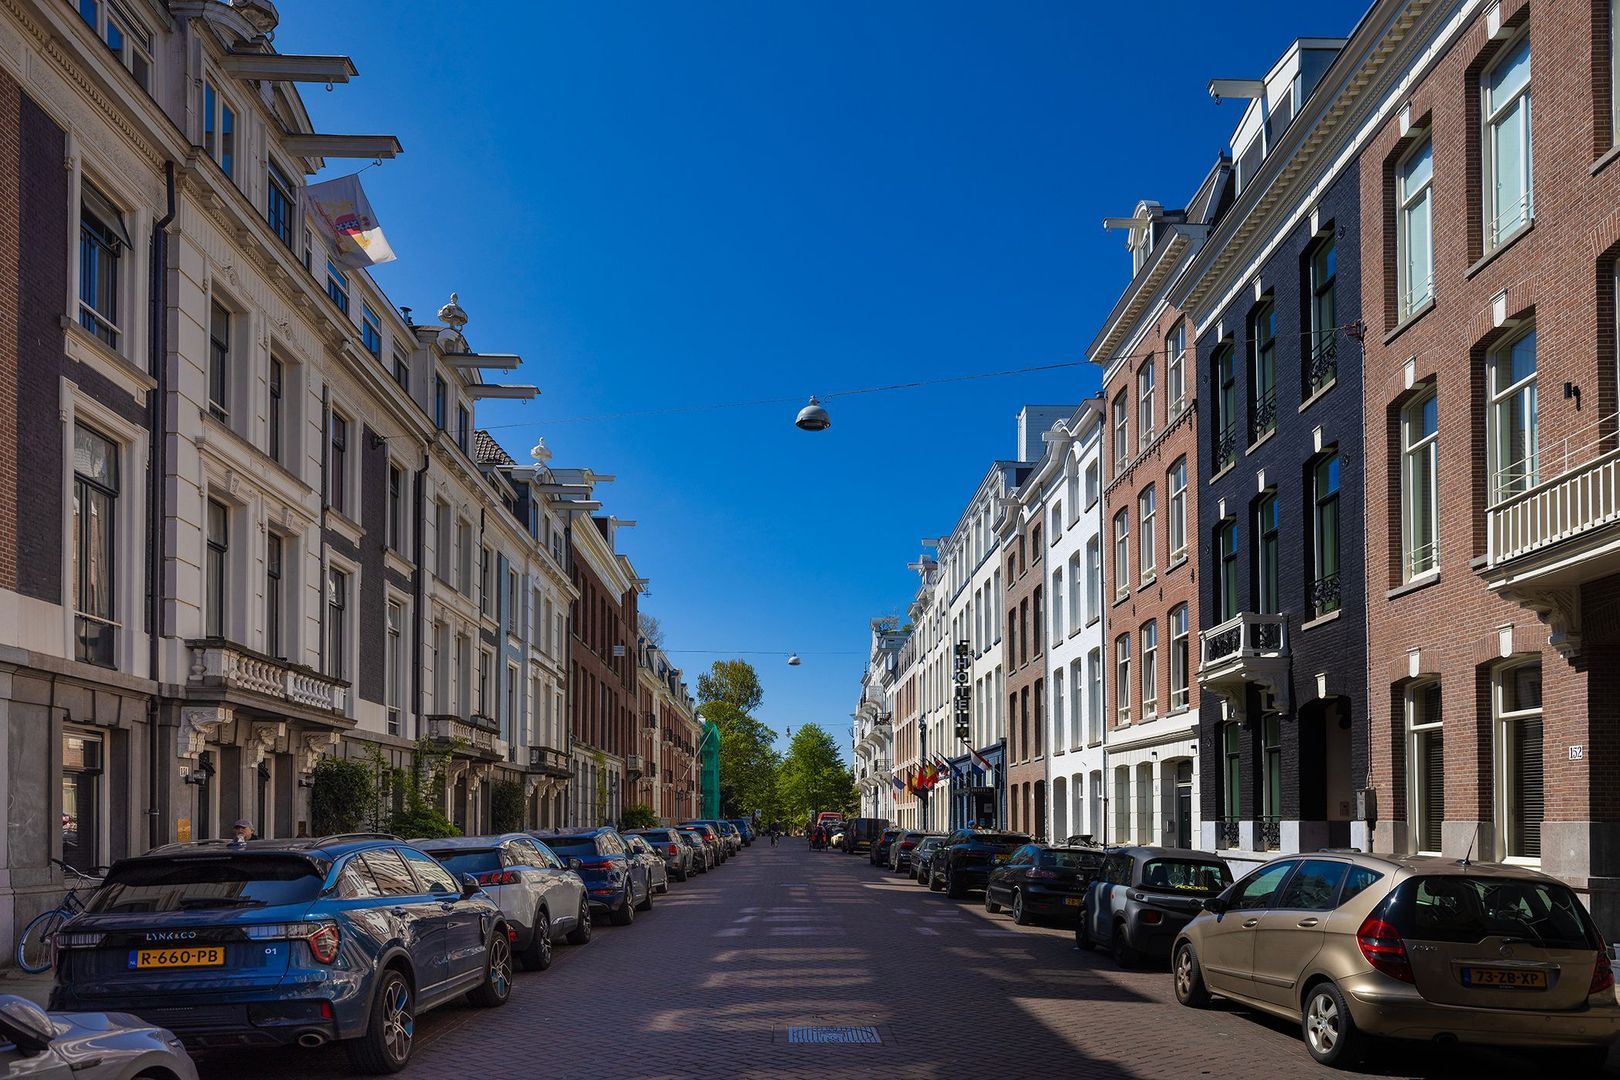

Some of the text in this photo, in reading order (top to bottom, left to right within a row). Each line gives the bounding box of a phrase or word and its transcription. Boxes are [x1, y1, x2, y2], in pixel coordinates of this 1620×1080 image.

[957, 658, 967, 724] HOTEL
[1570, 745, 1582, 758] 152
[141, 949, 218, 965] R-660-PB
[1476, 970, 1538, 984] 73-ZB-XP
